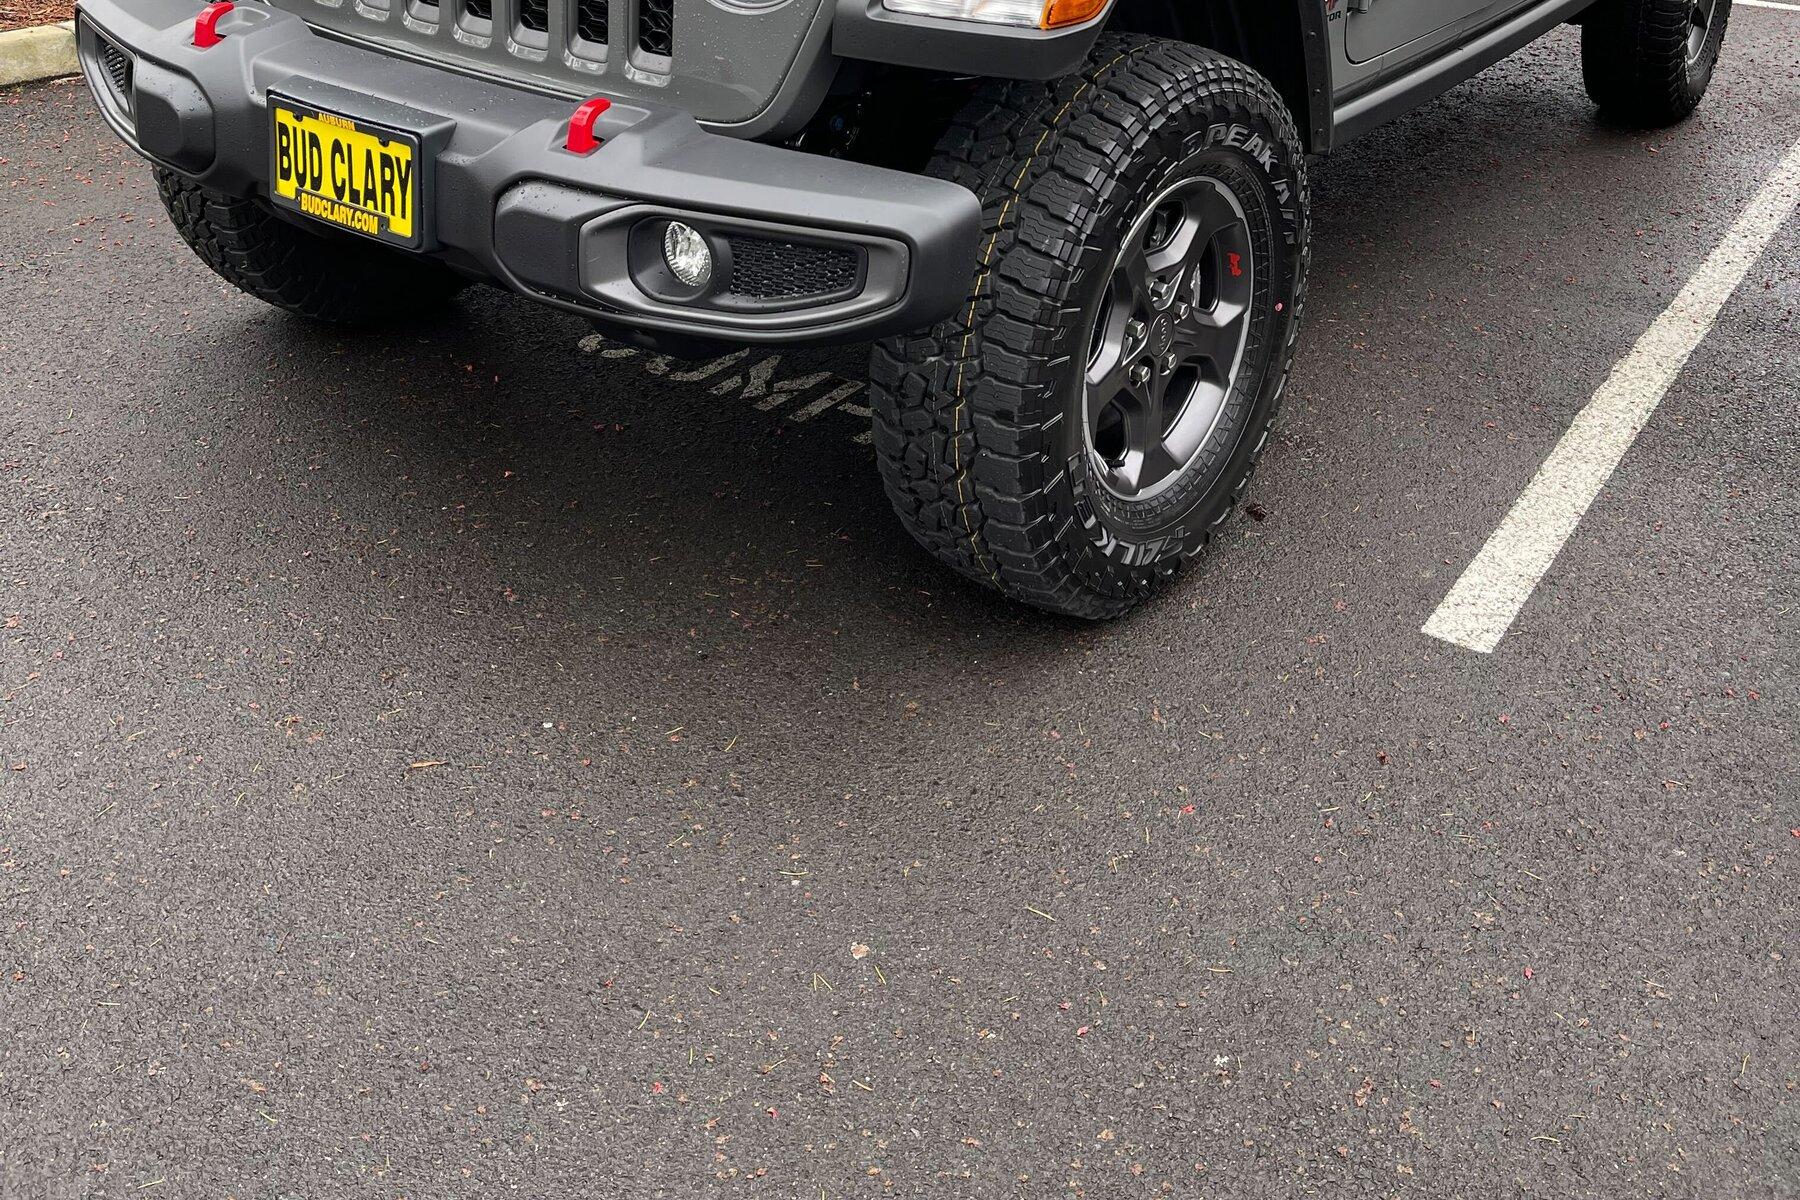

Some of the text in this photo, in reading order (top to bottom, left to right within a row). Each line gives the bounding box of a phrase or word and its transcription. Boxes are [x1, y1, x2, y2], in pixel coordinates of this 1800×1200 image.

[318, 112, 356, 131] AUBURN
[278, 122, 412, 220] BUD CLARY
[301, 193, 379, 235] BUDCLARY.COM
